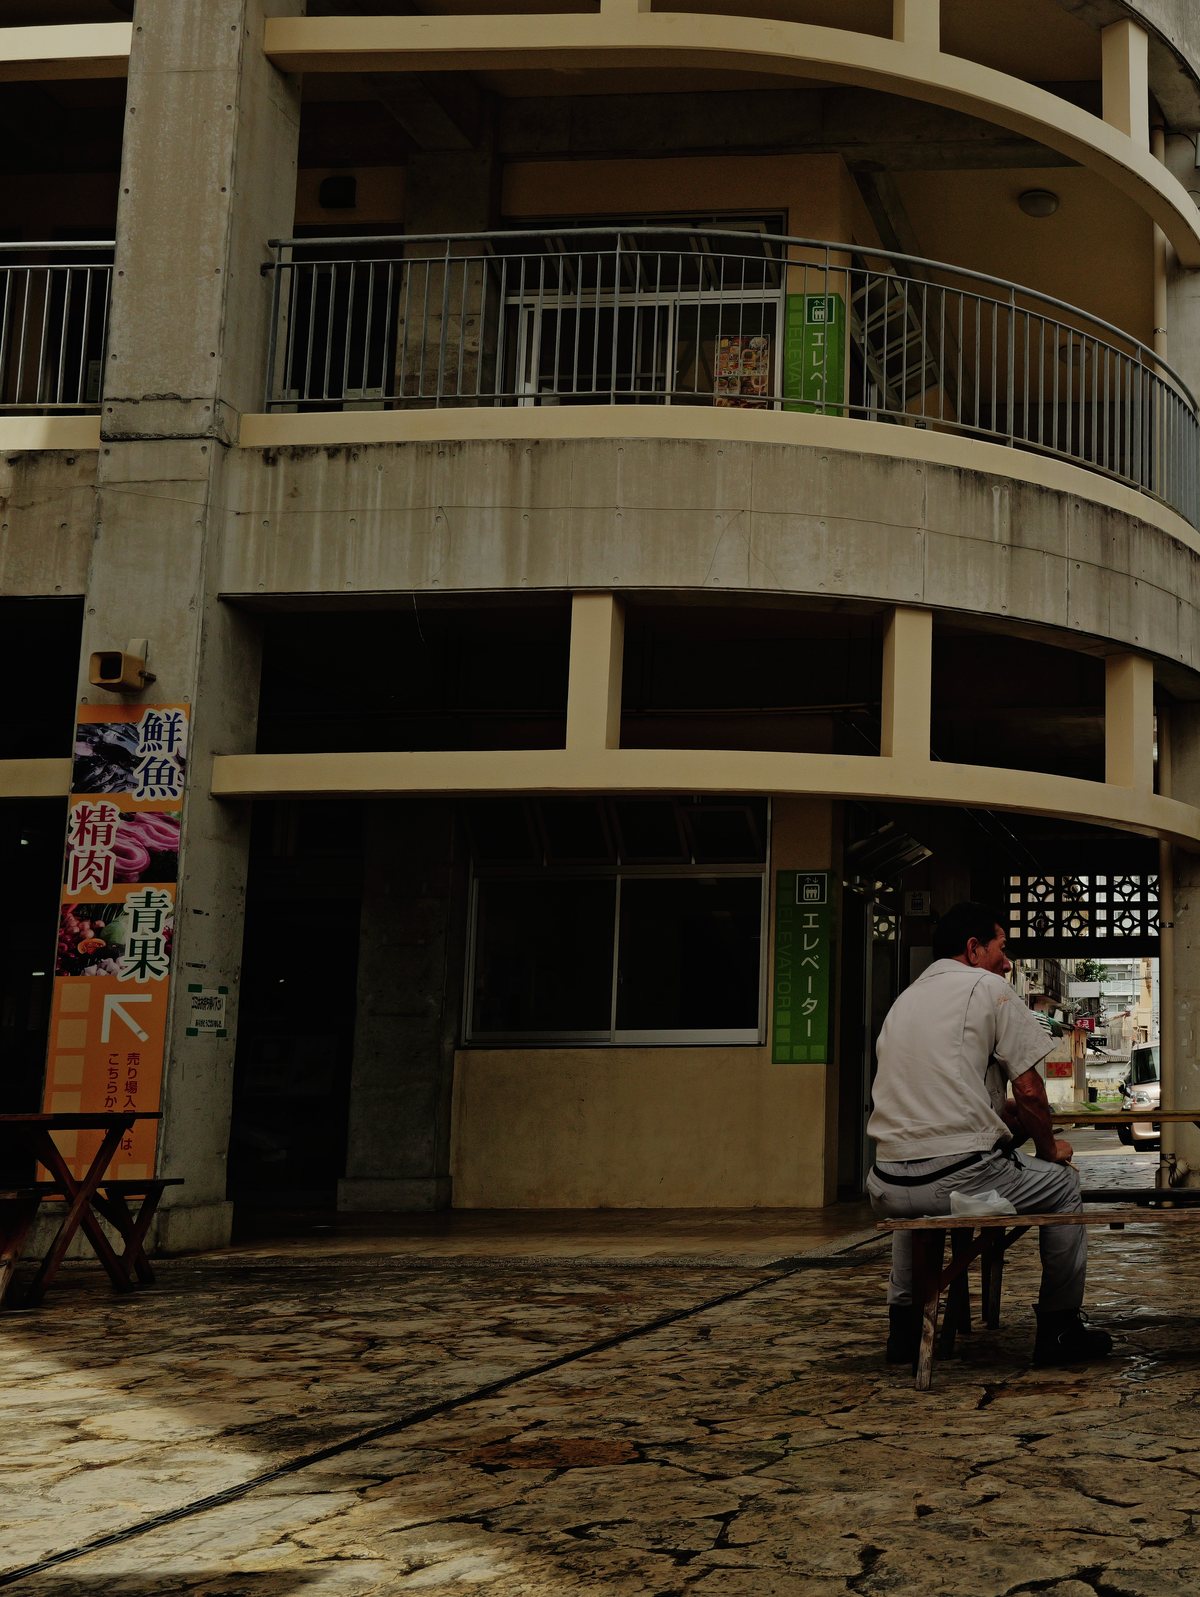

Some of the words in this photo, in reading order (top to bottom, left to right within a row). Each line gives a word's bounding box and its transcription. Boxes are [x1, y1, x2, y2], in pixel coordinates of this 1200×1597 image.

[136, 711, 183, 798] 鮮魚
[70, 804, 117, 892] 精肉
[124, 891, 169, 980] 青果
[777, 907, 793, 1008] ELEVATOR
[800, 912, 820, 1038] エレベーター
